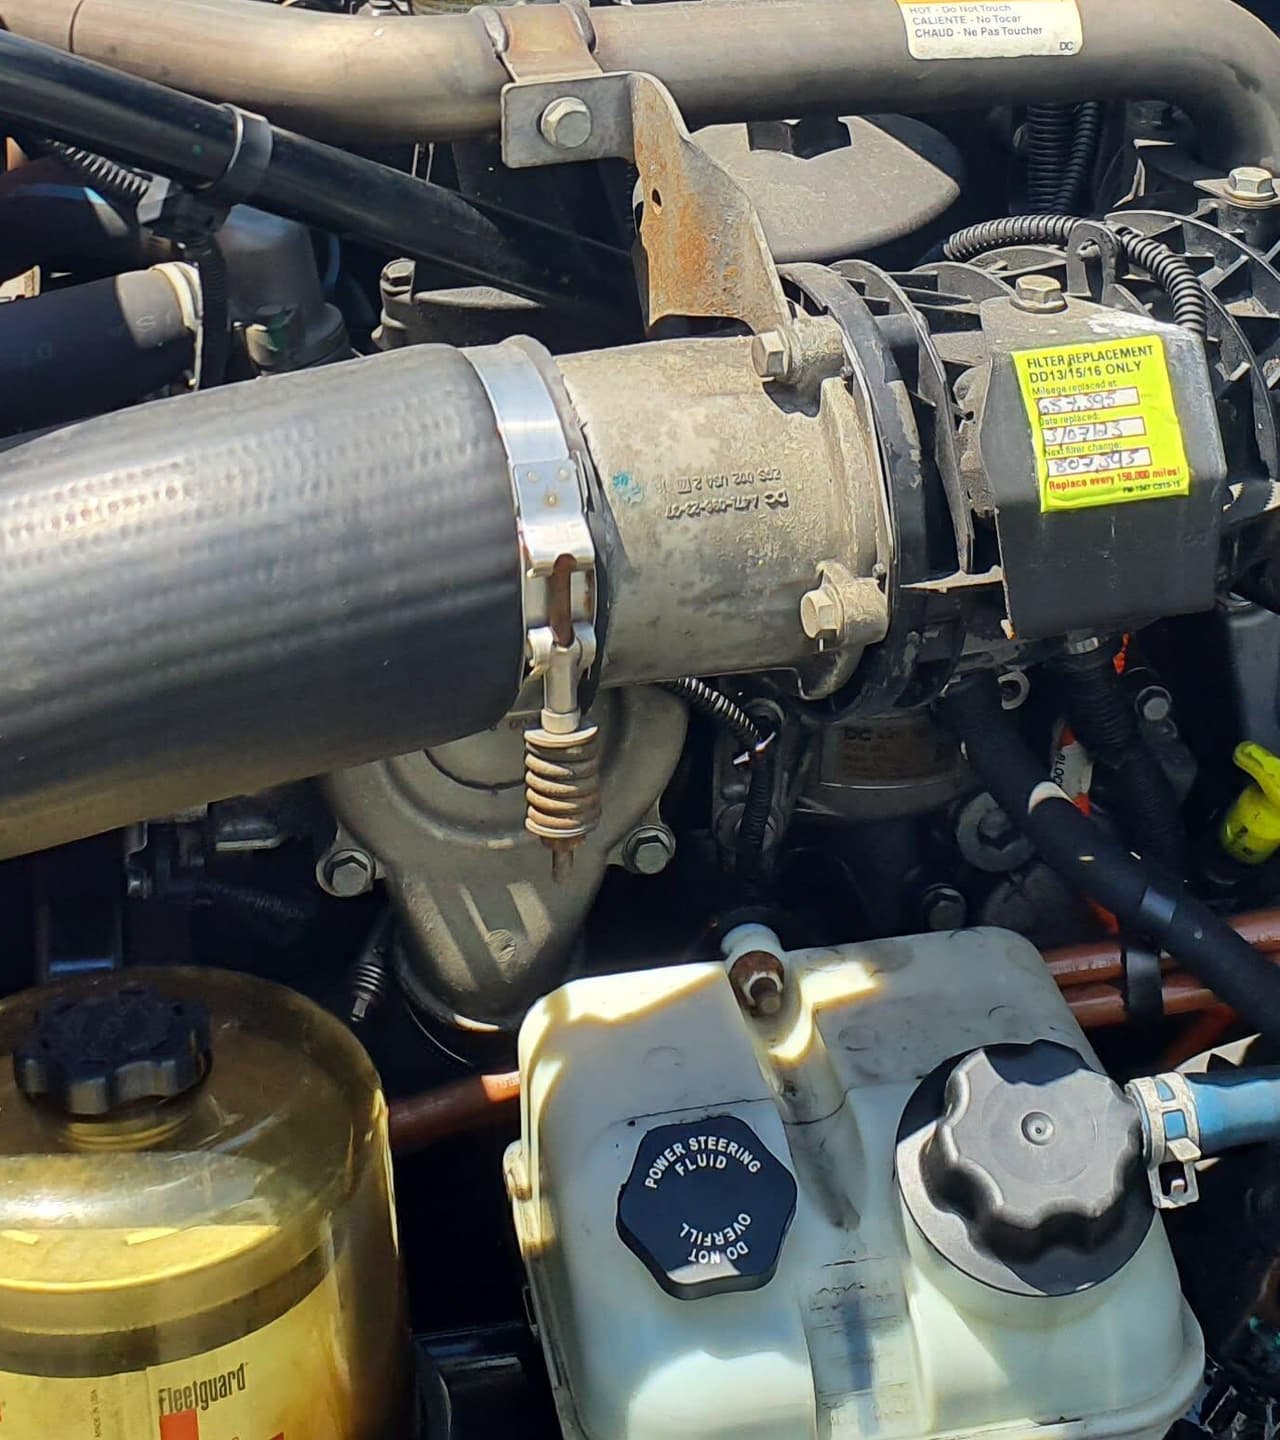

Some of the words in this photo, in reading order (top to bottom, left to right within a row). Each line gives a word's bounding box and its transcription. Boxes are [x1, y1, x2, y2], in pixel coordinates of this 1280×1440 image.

[910, 6, 932, 14] HOT
[942, 6, 956, 14] Do
[980, 3, 1012, 12] Touch
[912, 16, 967, 26] CALIENTE
[976, 16, 991, 24] No
[994, 14, 1022, 23] Tocar
[915, 29, 955, 39] CHAUD
[963, 28, 978, 37] Ne
[980, 27, 1000, 36] Pas
[1002, 26, 1043, 36] Toucher
[1059, 42, 1073, 51] DC
[1026, 354, 1066, 369] FILTER
[1068, 344, 1153, 365] REPLACEMENT
[1029, 365, 1102, 383] DD13/15/16
[1106, 360, 1142, 375] ONLY
[1032, 385, 1067, 396] Mileage
[1068, 380, 1106, 394] replaced
[1040, 415, 1058, 427] Date
[1045, 446, 1065, 458] Next
[1065, 444, 1086, 455] filter
[1049, 478, 1088, 492] Replace
[1089, 475, 1115, 486] every
[1152, 466, 1181, 479] miles!
[645, 1142, 687, 1188] POWER
[688, 1135, 762, 1173] STEERING
[674, 1154, 727, 1176] FLUID
[679, 1213, 751, 1247] OVERFILL
[687, 1247, 720, 1264] NOT
[726, 1241, 749, 1260] DO
[158, 1362, 246, 1416] Fleetguard
